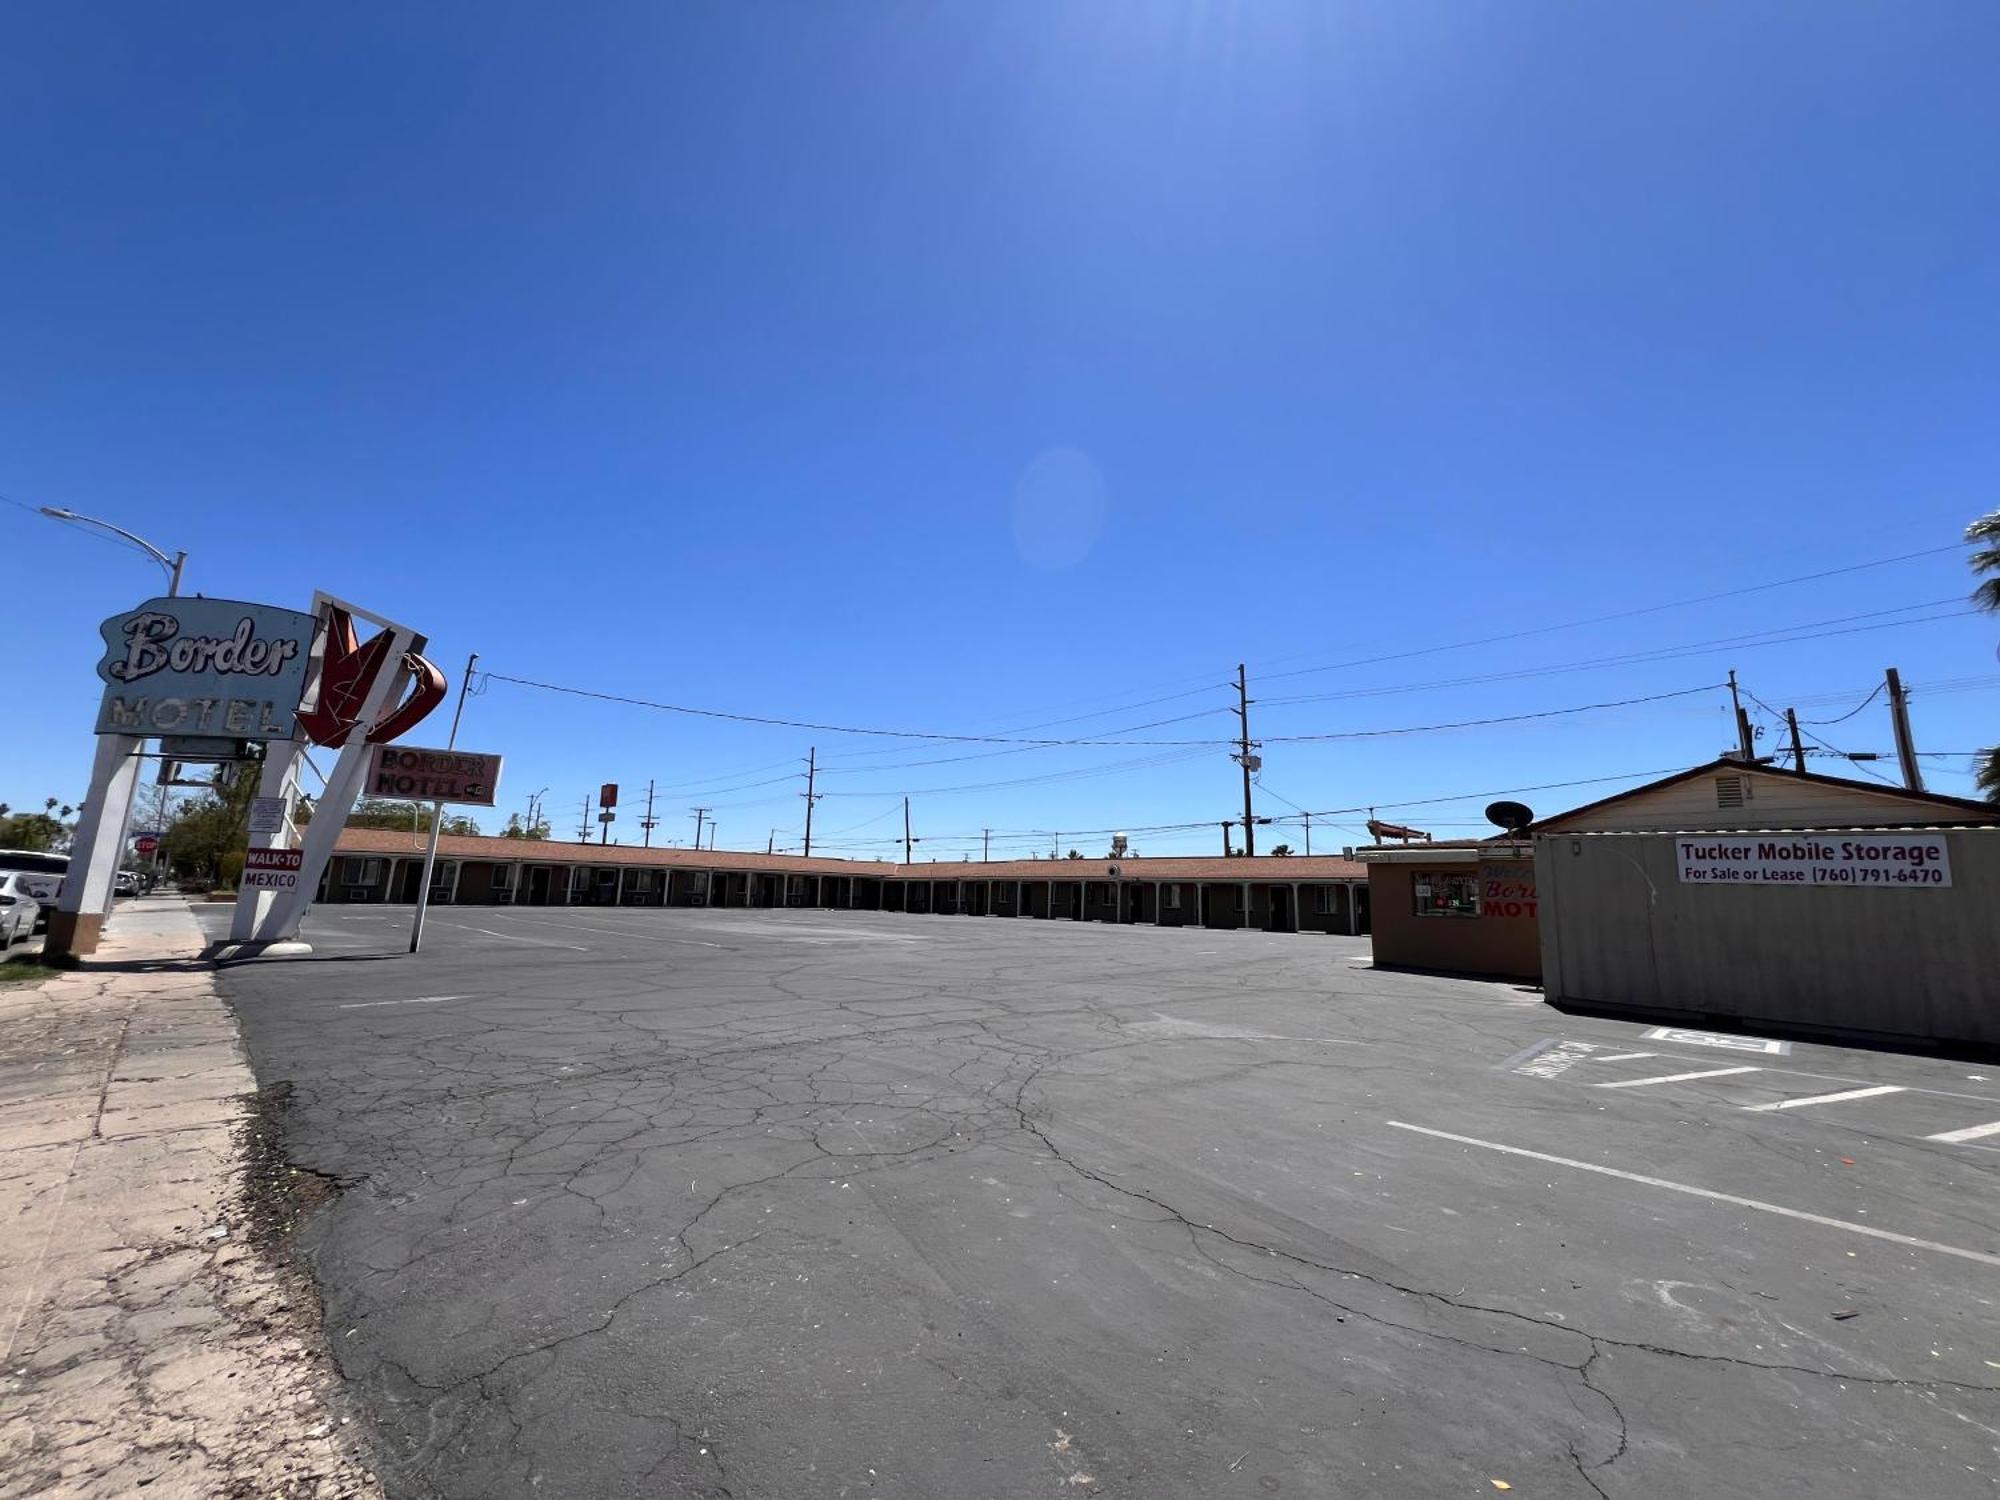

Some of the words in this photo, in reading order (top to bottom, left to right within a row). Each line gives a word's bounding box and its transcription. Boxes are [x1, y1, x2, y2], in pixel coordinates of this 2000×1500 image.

[109, 611, 299, 684] Border
[109, 696, 284, 734] MOTEL
[381, 749, 486, 776] BORDER
[376, 773, 462, 798] MOTEL
[1681, 844, 1751, 860] Tucker
[1758, 843, 1834, 860] Mobile
[1841, 842, 1940, 866] Storage
[245, 873, 296, 887] MEXICO
[1685, 868, 1707, 879] For
[1711, 868, 1739, 880] Sale
[1743, 870, 1758, 880] or
[1763, 868, 1805, 881] Lease
[1812, 867, 1856, 883] (760)
[1860, 869, 1943, 882] 791-6470
